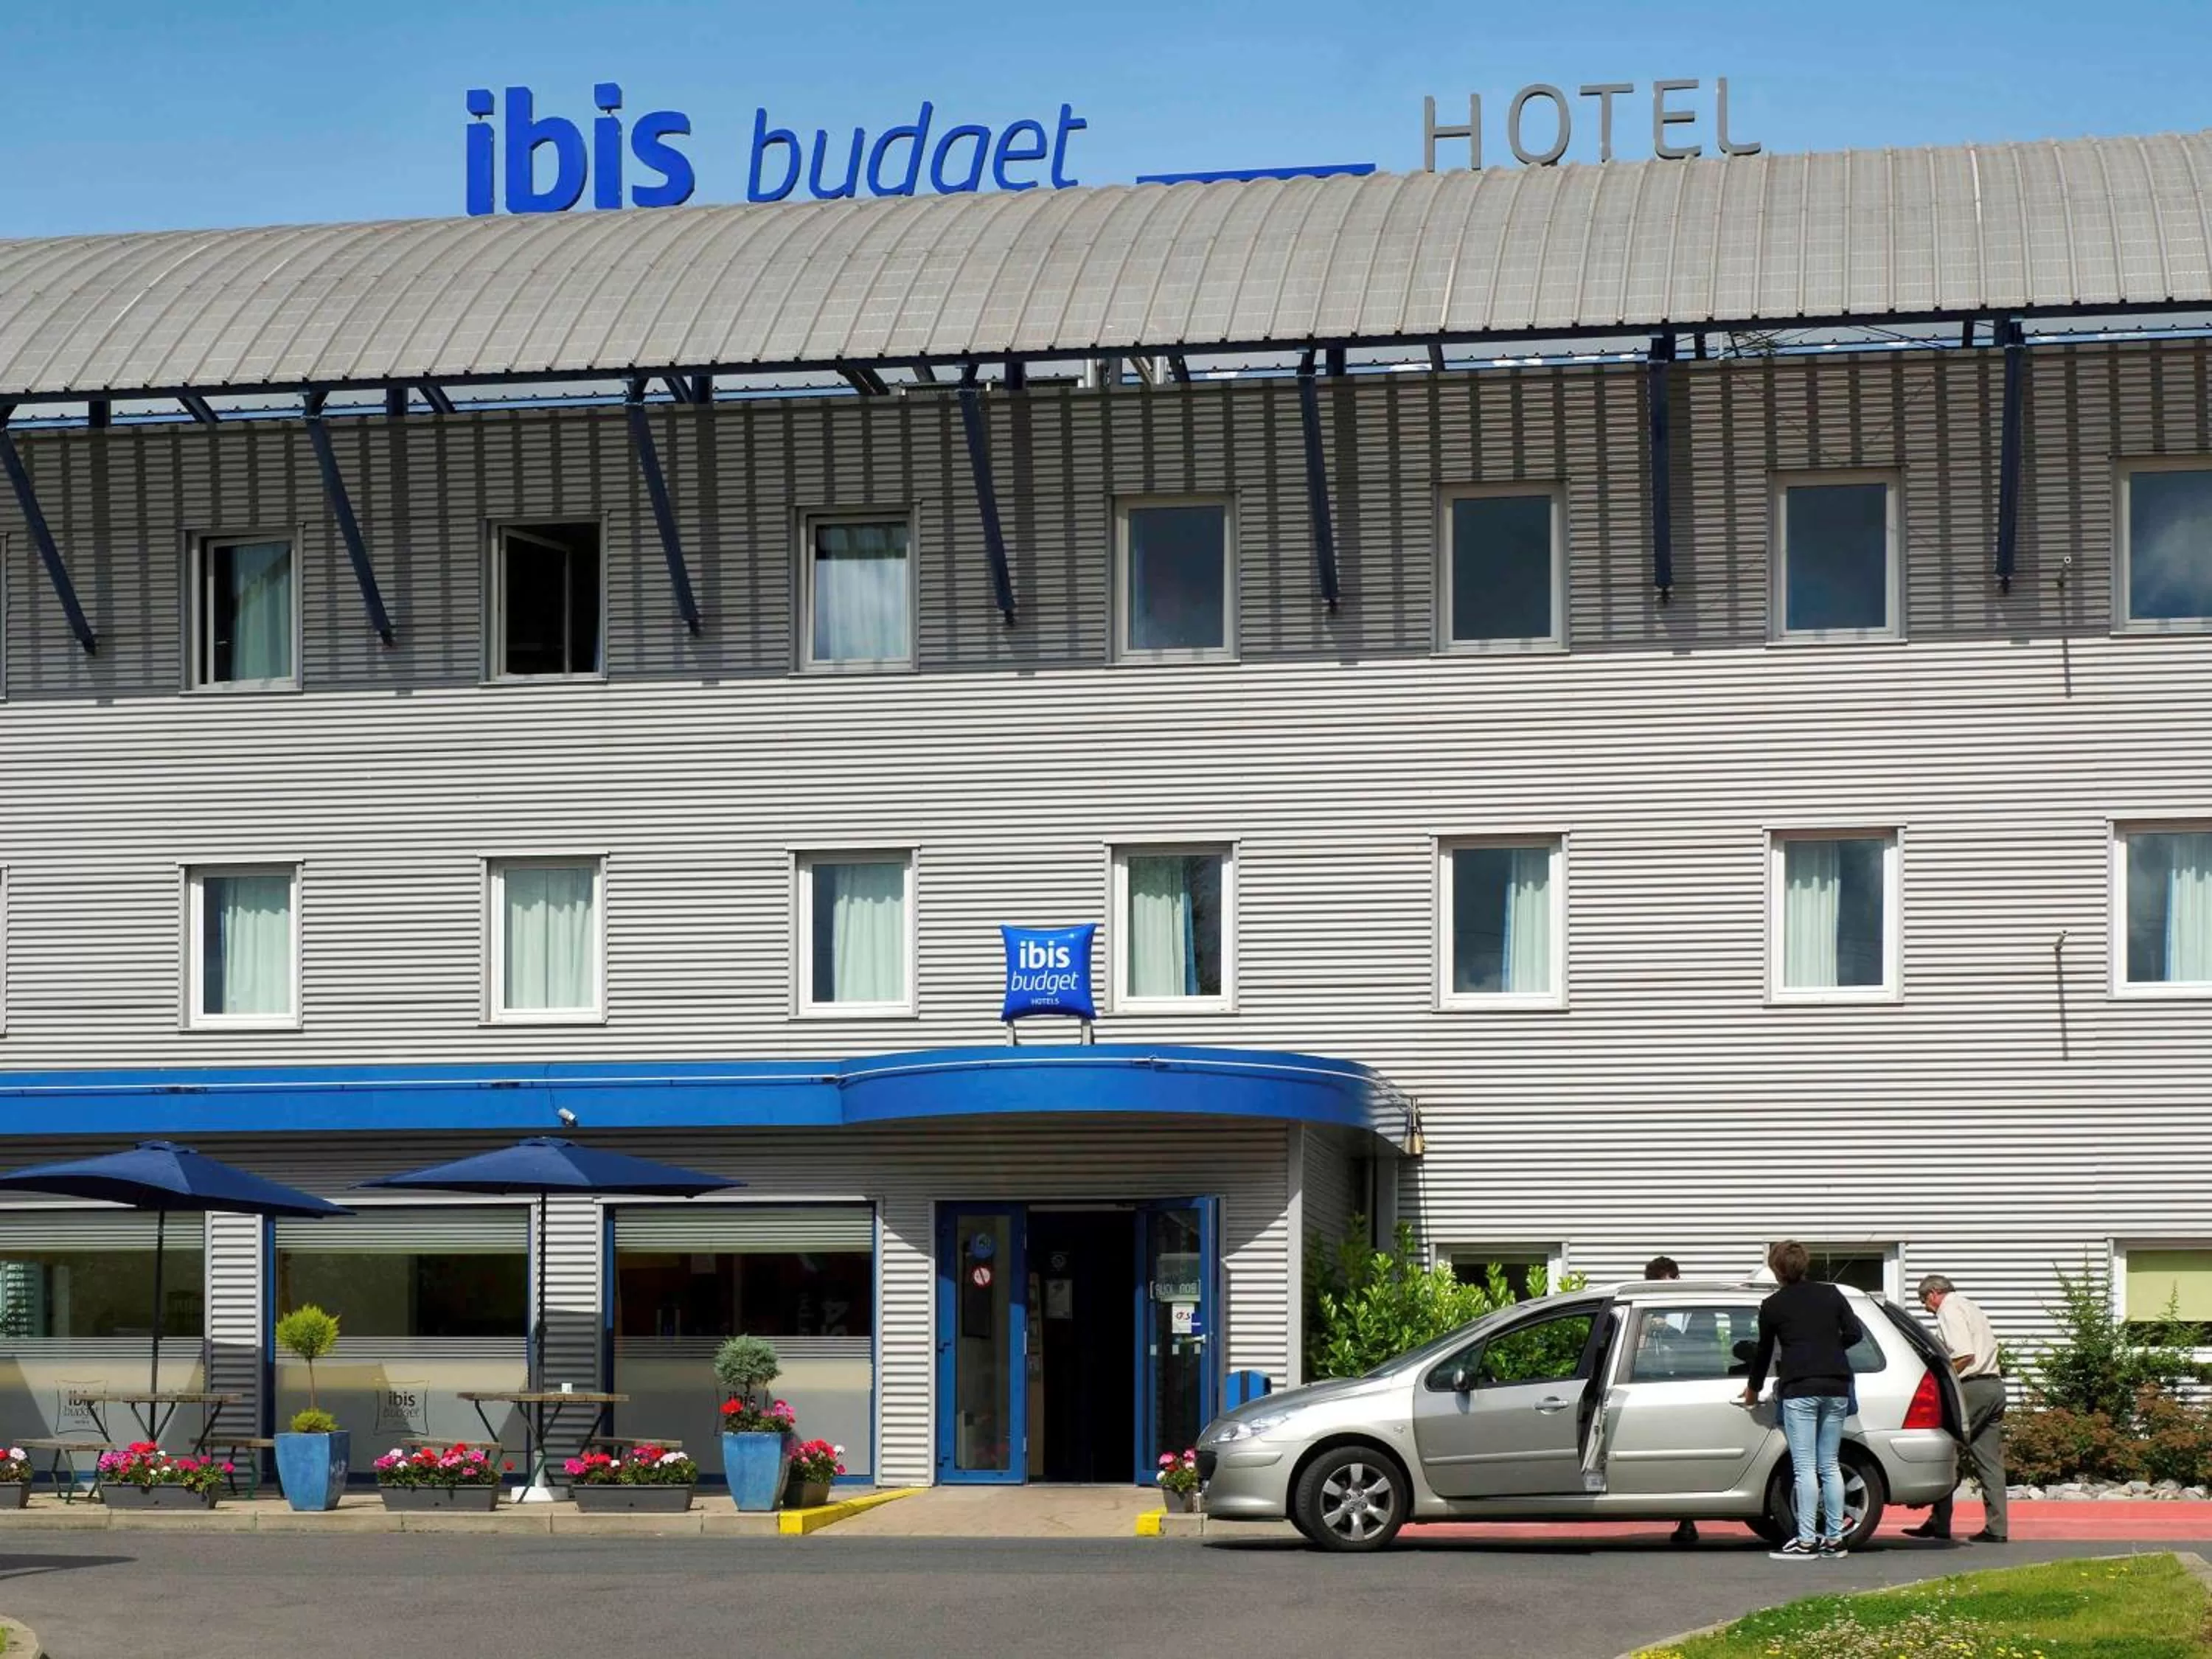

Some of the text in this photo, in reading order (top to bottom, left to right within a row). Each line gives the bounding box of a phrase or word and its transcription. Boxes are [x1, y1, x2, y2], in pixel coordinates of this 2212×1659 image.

[1424, 77, 1761, 173] HOTEL
[466, 82, 695, 216] ibis
[1020, 940, 1071, 969] ibis
[1011, 970, 1079, 995] budget
[389, 1391, 415, 1407] ibis
